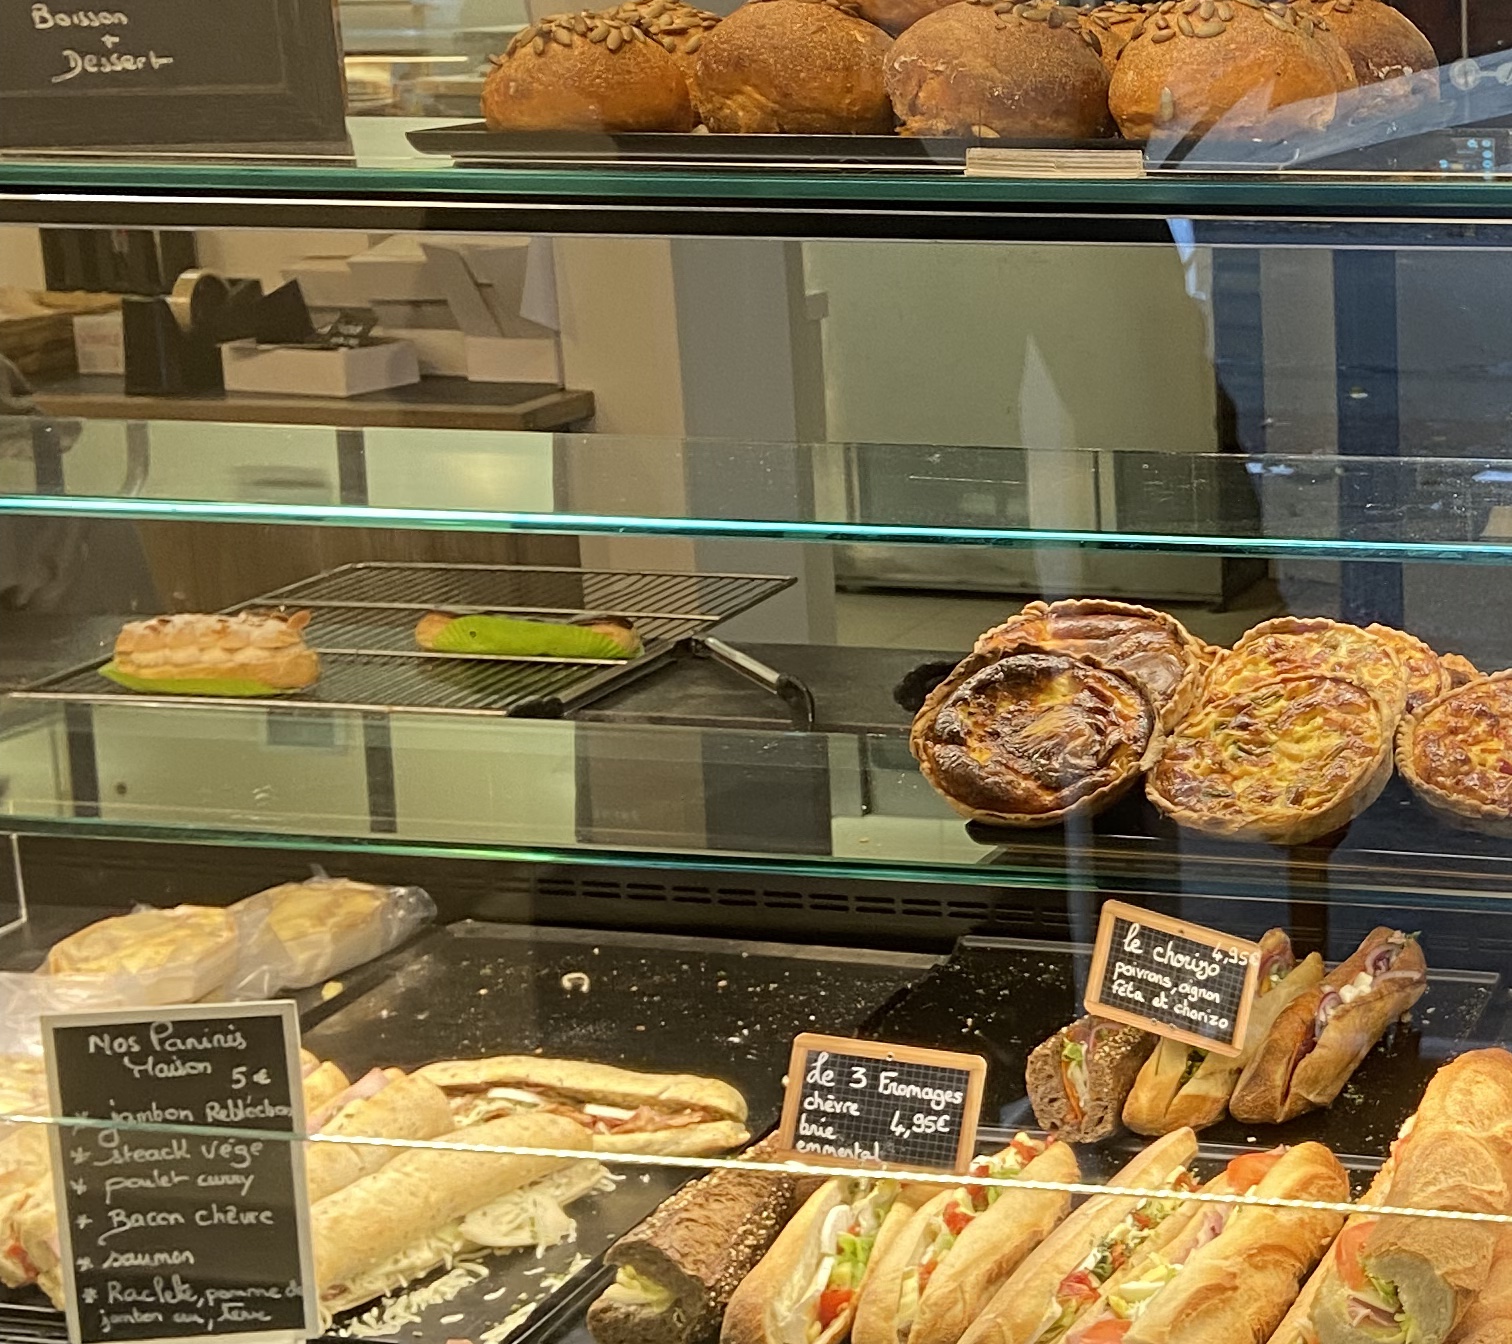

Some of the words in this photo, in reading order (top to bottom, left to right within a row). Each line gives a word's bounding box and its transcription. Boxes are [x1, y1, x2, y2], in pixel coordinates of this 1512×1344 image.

[31, 3, 129, 29] Boisson
[51, 49, 174, 83] Dessert
[1151, 991, 1169, 1010] et
[1173, 999, 1229, 1029] chorizo
[849, 1067, 867, 1088] 3
[878, 1071, 964, 1110] Fromages
[799, 1113, 837, 1139] brie
[889, 1110, 951, 1139] 4,95€
